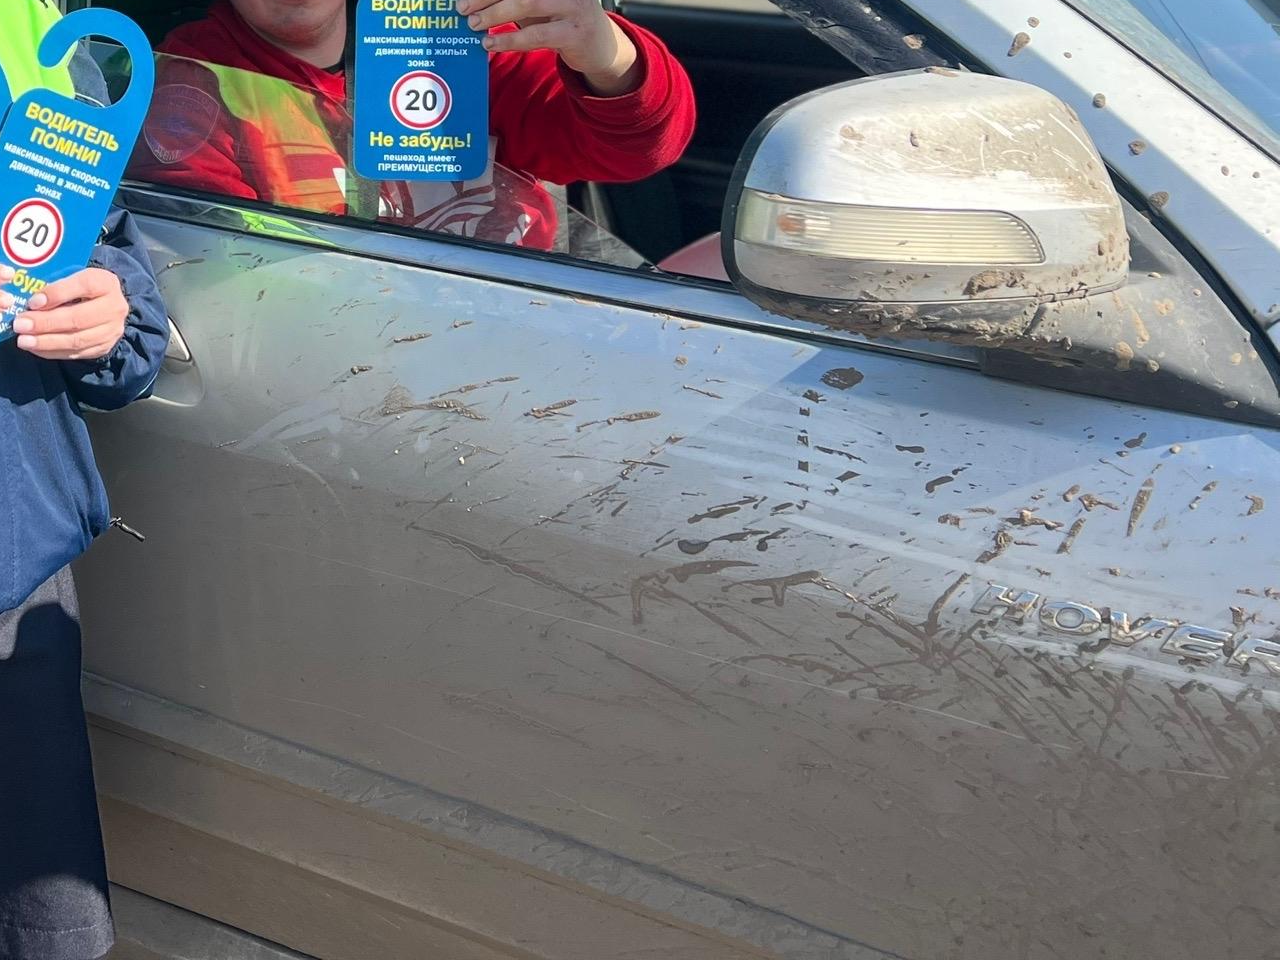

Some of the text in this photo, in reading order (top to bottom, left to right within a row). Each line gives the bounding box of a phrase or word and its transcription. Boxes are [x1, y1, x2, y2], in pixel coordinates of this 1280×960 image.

[384, 15, 459, 29] ПОМНИ!
[363, 36, 481, 46] максимальная скорость
[374, 48, 423, 57] движения
[434, 48, 468, 56] жилых
[407, 59, 435, 67] зонах
[404, 89, 438, 112] 20
[25, 101, 119, 152] ВОДИТЕЛЬ
[30, 127, 101, 167] ПОМНИ!
[369, 131, 472, 152] Не забудь!
[4, 142, 111, 190] максимальная скорость
[377, 163, 462, 173] ПРЕИМУЩЕСТВО
[383, 154, 457, 163] пешеход имеет
[9, 160, 96, 199] движения в жилых
[35, 184, 63, 201] зонах
[14, 217, 49, 248] 20
[970, 582, 1280, 677] HOVER
